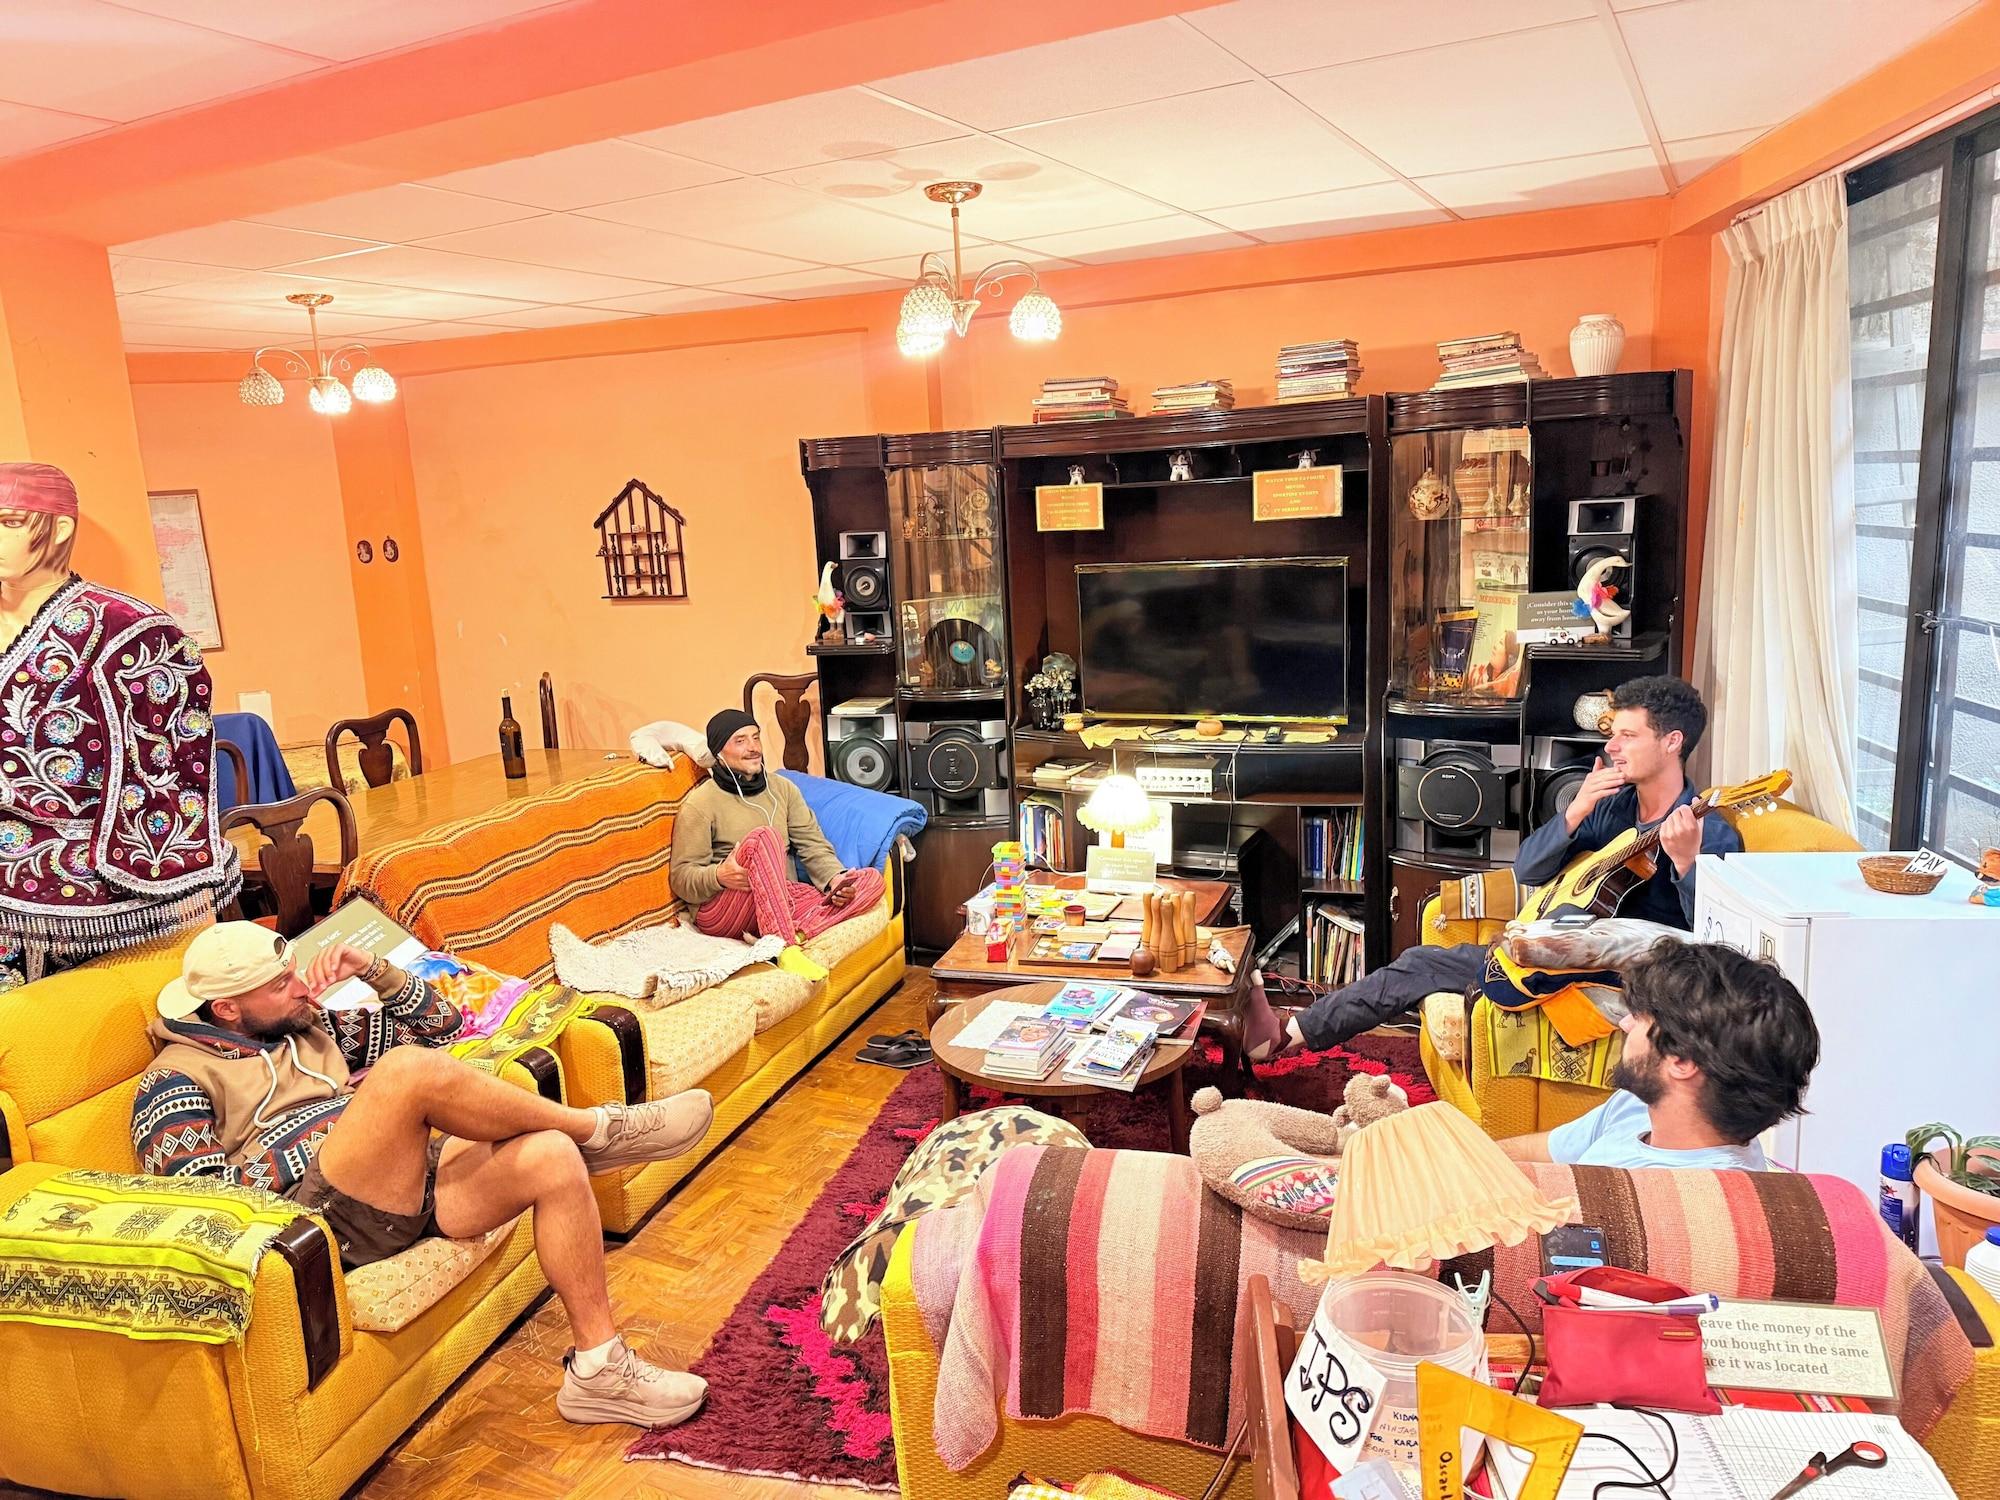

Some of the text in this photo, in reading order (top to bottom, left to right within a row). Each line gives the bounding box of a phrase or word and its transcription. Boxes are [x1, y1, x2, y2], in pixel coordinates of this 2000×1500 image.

[1914, 851, 1945, 871] PAY
[1700, 1318, 1857, 1338] eave the money of the
[1702, 1337, 1869, 1358] you bought in the same
[1703, 1356, 1829, 1375] ace it was located
[1392, 1411, 1419, 1421] KIDNA
[1369, 1432, 1419, 1447] FOR KARA
[1440, 1451, 1453, 1492] Oscar
